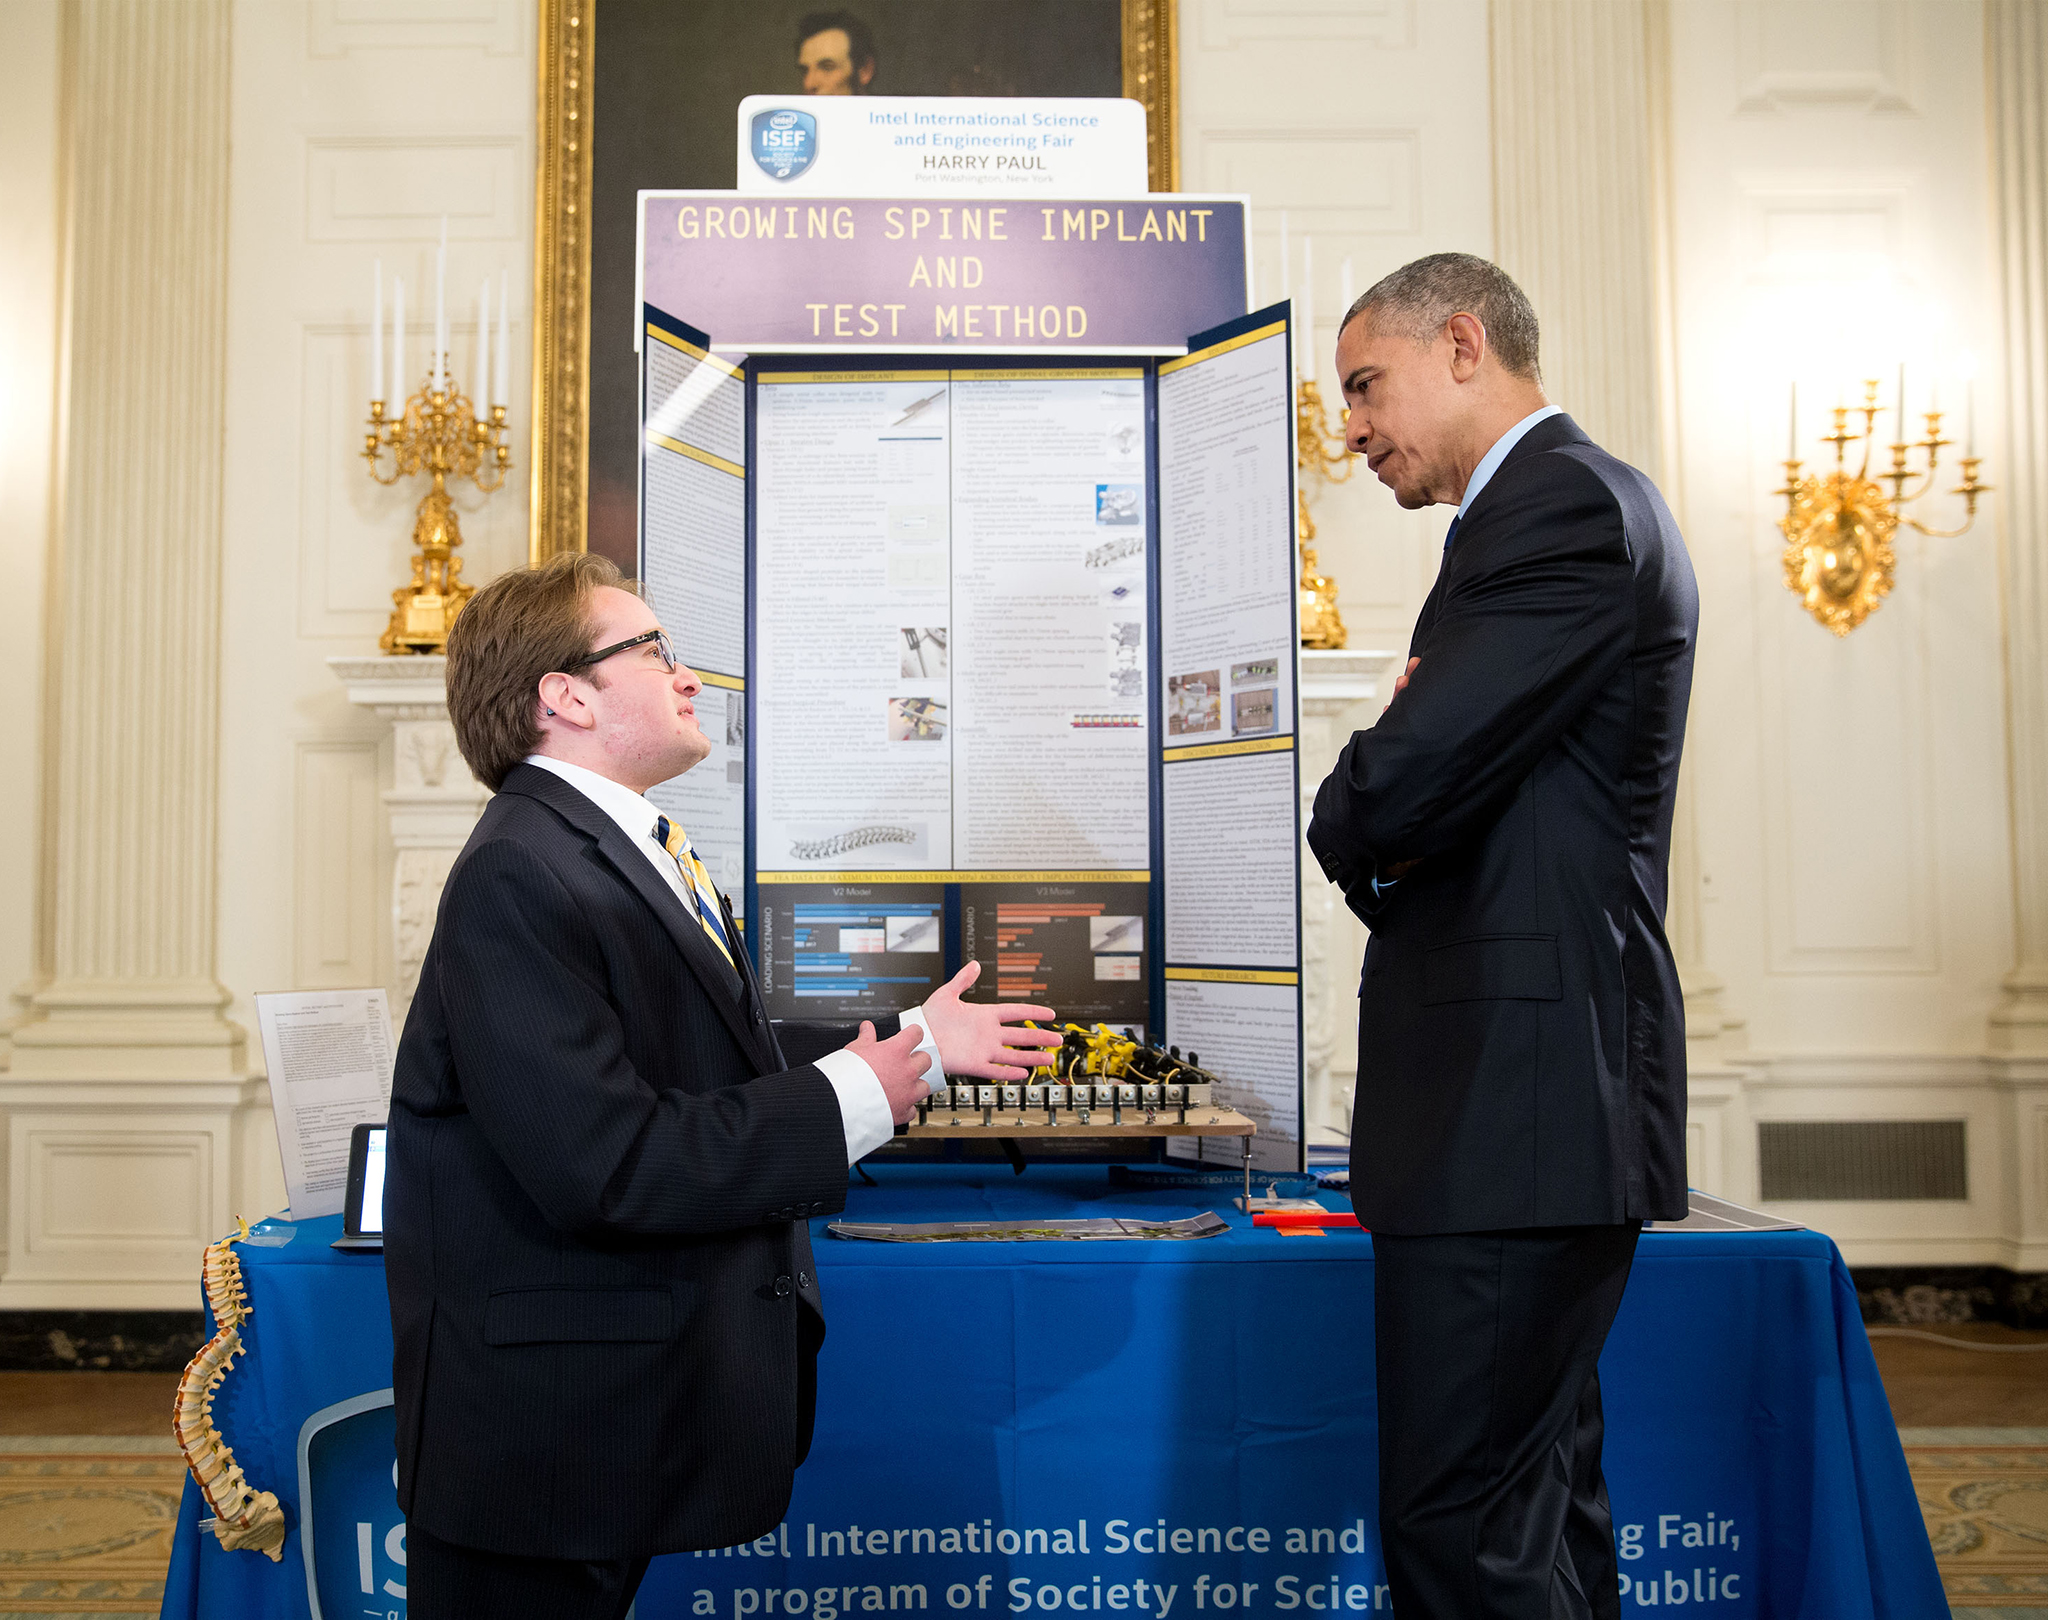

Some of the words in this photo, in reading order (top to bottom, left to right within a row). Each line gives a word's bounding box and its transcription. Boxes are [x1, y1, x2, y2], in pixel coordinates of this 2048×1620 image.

[869, 112, 908, 125] Intel
[914, 112, 1026, 126] International
[1032, 113, 1099, 127] Science
[762, 130, 806, 147] ISEF
[894, 132, 926, 146] and
[933, 133, 1037, 149] Engineering
[1043, 134, 1075, 147] Fair
[915, 174, 936, 182] Port
[940, 174, 1002, 184] Washington,
[1007, 174, 1028, 183] New
[1032, 174, 1054, 183] York
[924, 155, 989, 169] HARRY
[997, 156, 1047, 170] PAUL
[677, 206, 855, 240] GROWING
[884, 207, 1009, 241] SPINE
[1041, 208, 1213, 242] IMPLANT
[908, 255, 985, 289] AND
[806, 303, 906, 337] TEST
[935, 304, 1088, 338] METHOD
[774, 872, 789, 881] FEA
[792, 872, 813, 881] DATA
[815, 872, 827, 881] OF
[829, 871, 873, 881] MAXIMUM
[875, 871, 893, 881] VON
[925, 871, 953, 881] STRESS
[978, 871, 1011, 880] ACROSS
[1013, 871, 1036, 880] OPUS
[1043, 871, 1080, 880] IMPLANT
[1082, 871, 1134, 880] ITERATIONS
[846, 887, 872, 896] Model
[764, 906, 773, 952] SCENARIO
[966, 906, 975, 952] SCENARIO
[764, 952, 773, 994] LOADING
[807, 1519, 1090, 1556] International
[1105, 1519, 1271, 1554] Science
[1285, 1519, 1365, 1554] and
[1659, 1512, 1740, 1552] Fair,
[693, 1589, 715, 1616] a
[735, 1584, 928, 1620] program
[946, 1575, 992, 1609] of
[1008, 1576, 1178, 1619] Society
[1193, 1575, 1259, 1609] for
[1275, 1575, 1394, 1610] Scien
